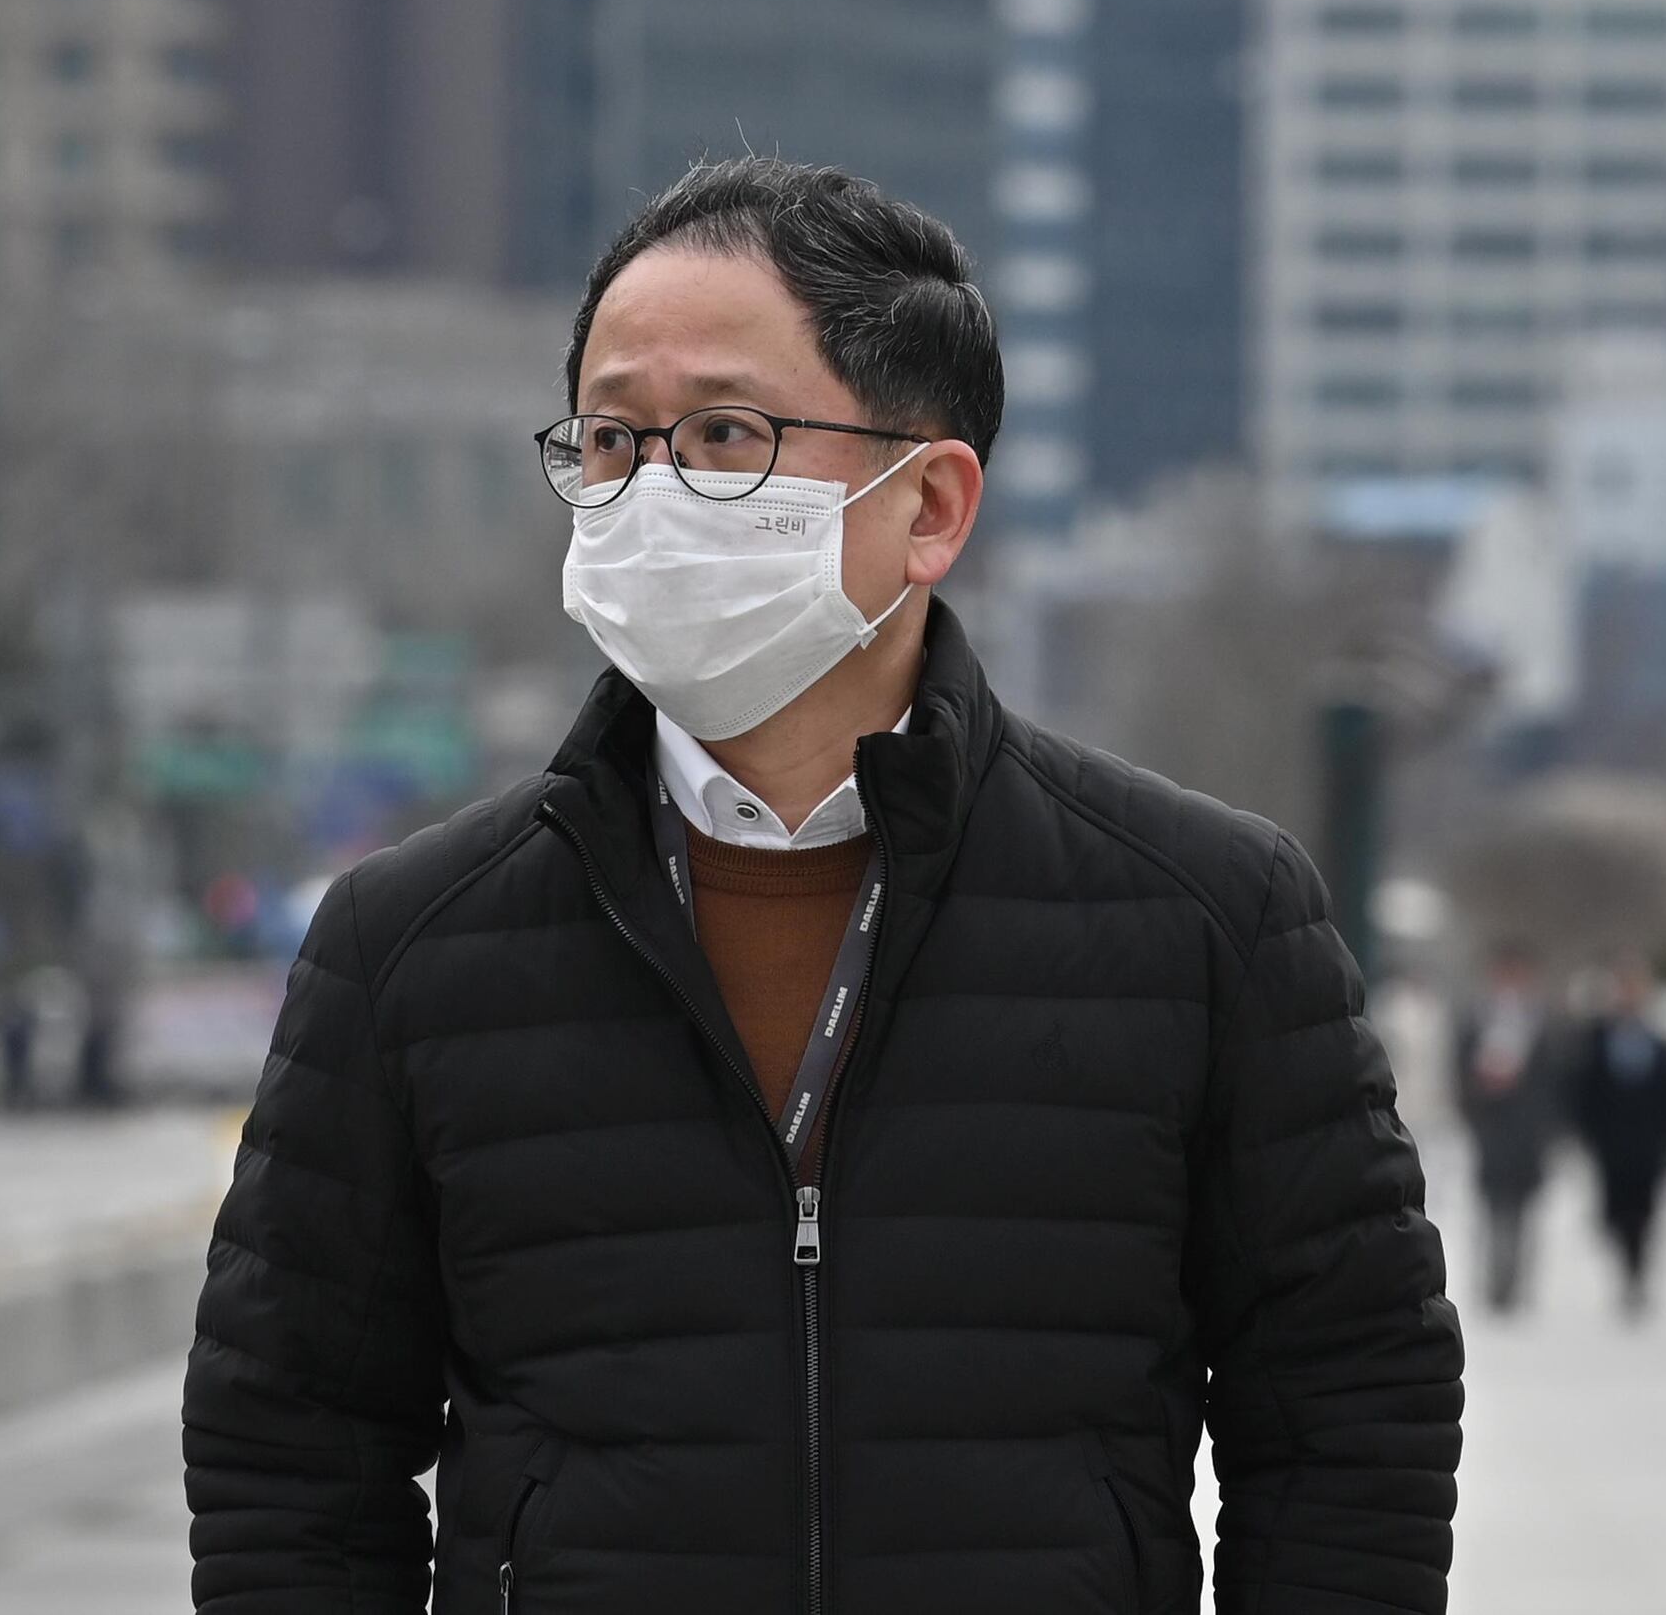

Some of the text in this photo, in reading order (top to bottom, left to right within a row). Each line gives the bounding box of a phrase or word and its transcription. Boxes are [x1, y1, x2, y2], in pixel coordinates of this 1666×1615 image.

[755, 516, 806, 536] 그린비
[668, 855, 686, 906] DAELIM
[859, 883, 882, 933] DAELIM
[824, 986, 849, 1038] DAELIM
[785, 1091, 812, 1144] DAELIM
